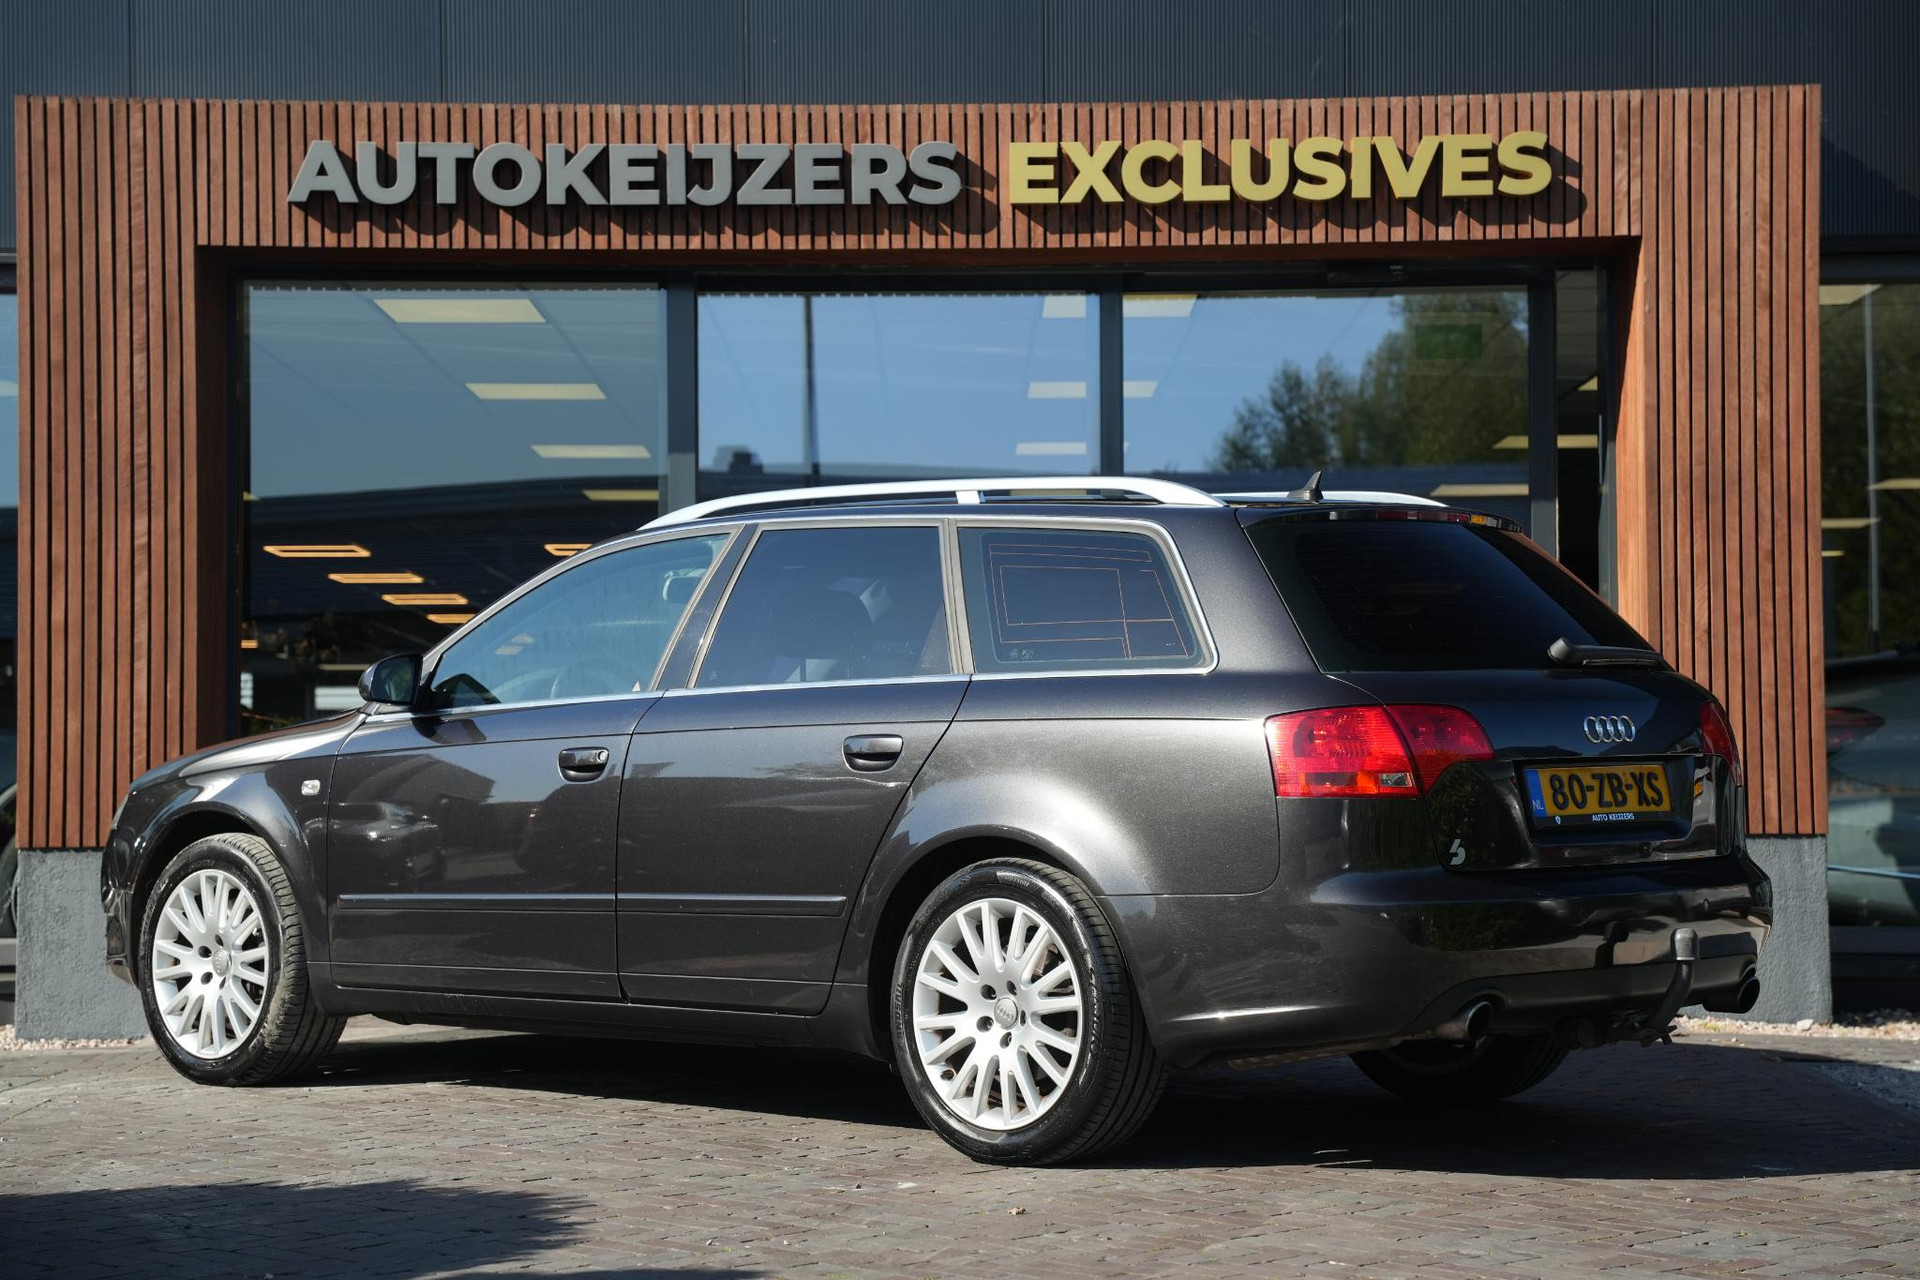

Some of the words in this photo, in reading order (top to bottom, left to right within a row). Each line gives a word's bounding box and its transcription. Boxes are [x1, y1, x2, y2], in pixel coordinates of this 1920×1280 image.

[287, 139, 963, 207] AUTOKEIJZERS
[1009, 131, 1553, 204] EXCLUSIVES
[1550, 772, 1664, 810] 80-ZB-XS
[1532, 799, 1544, 811] NL
[1592, 814, 1608, 822] AUTO
